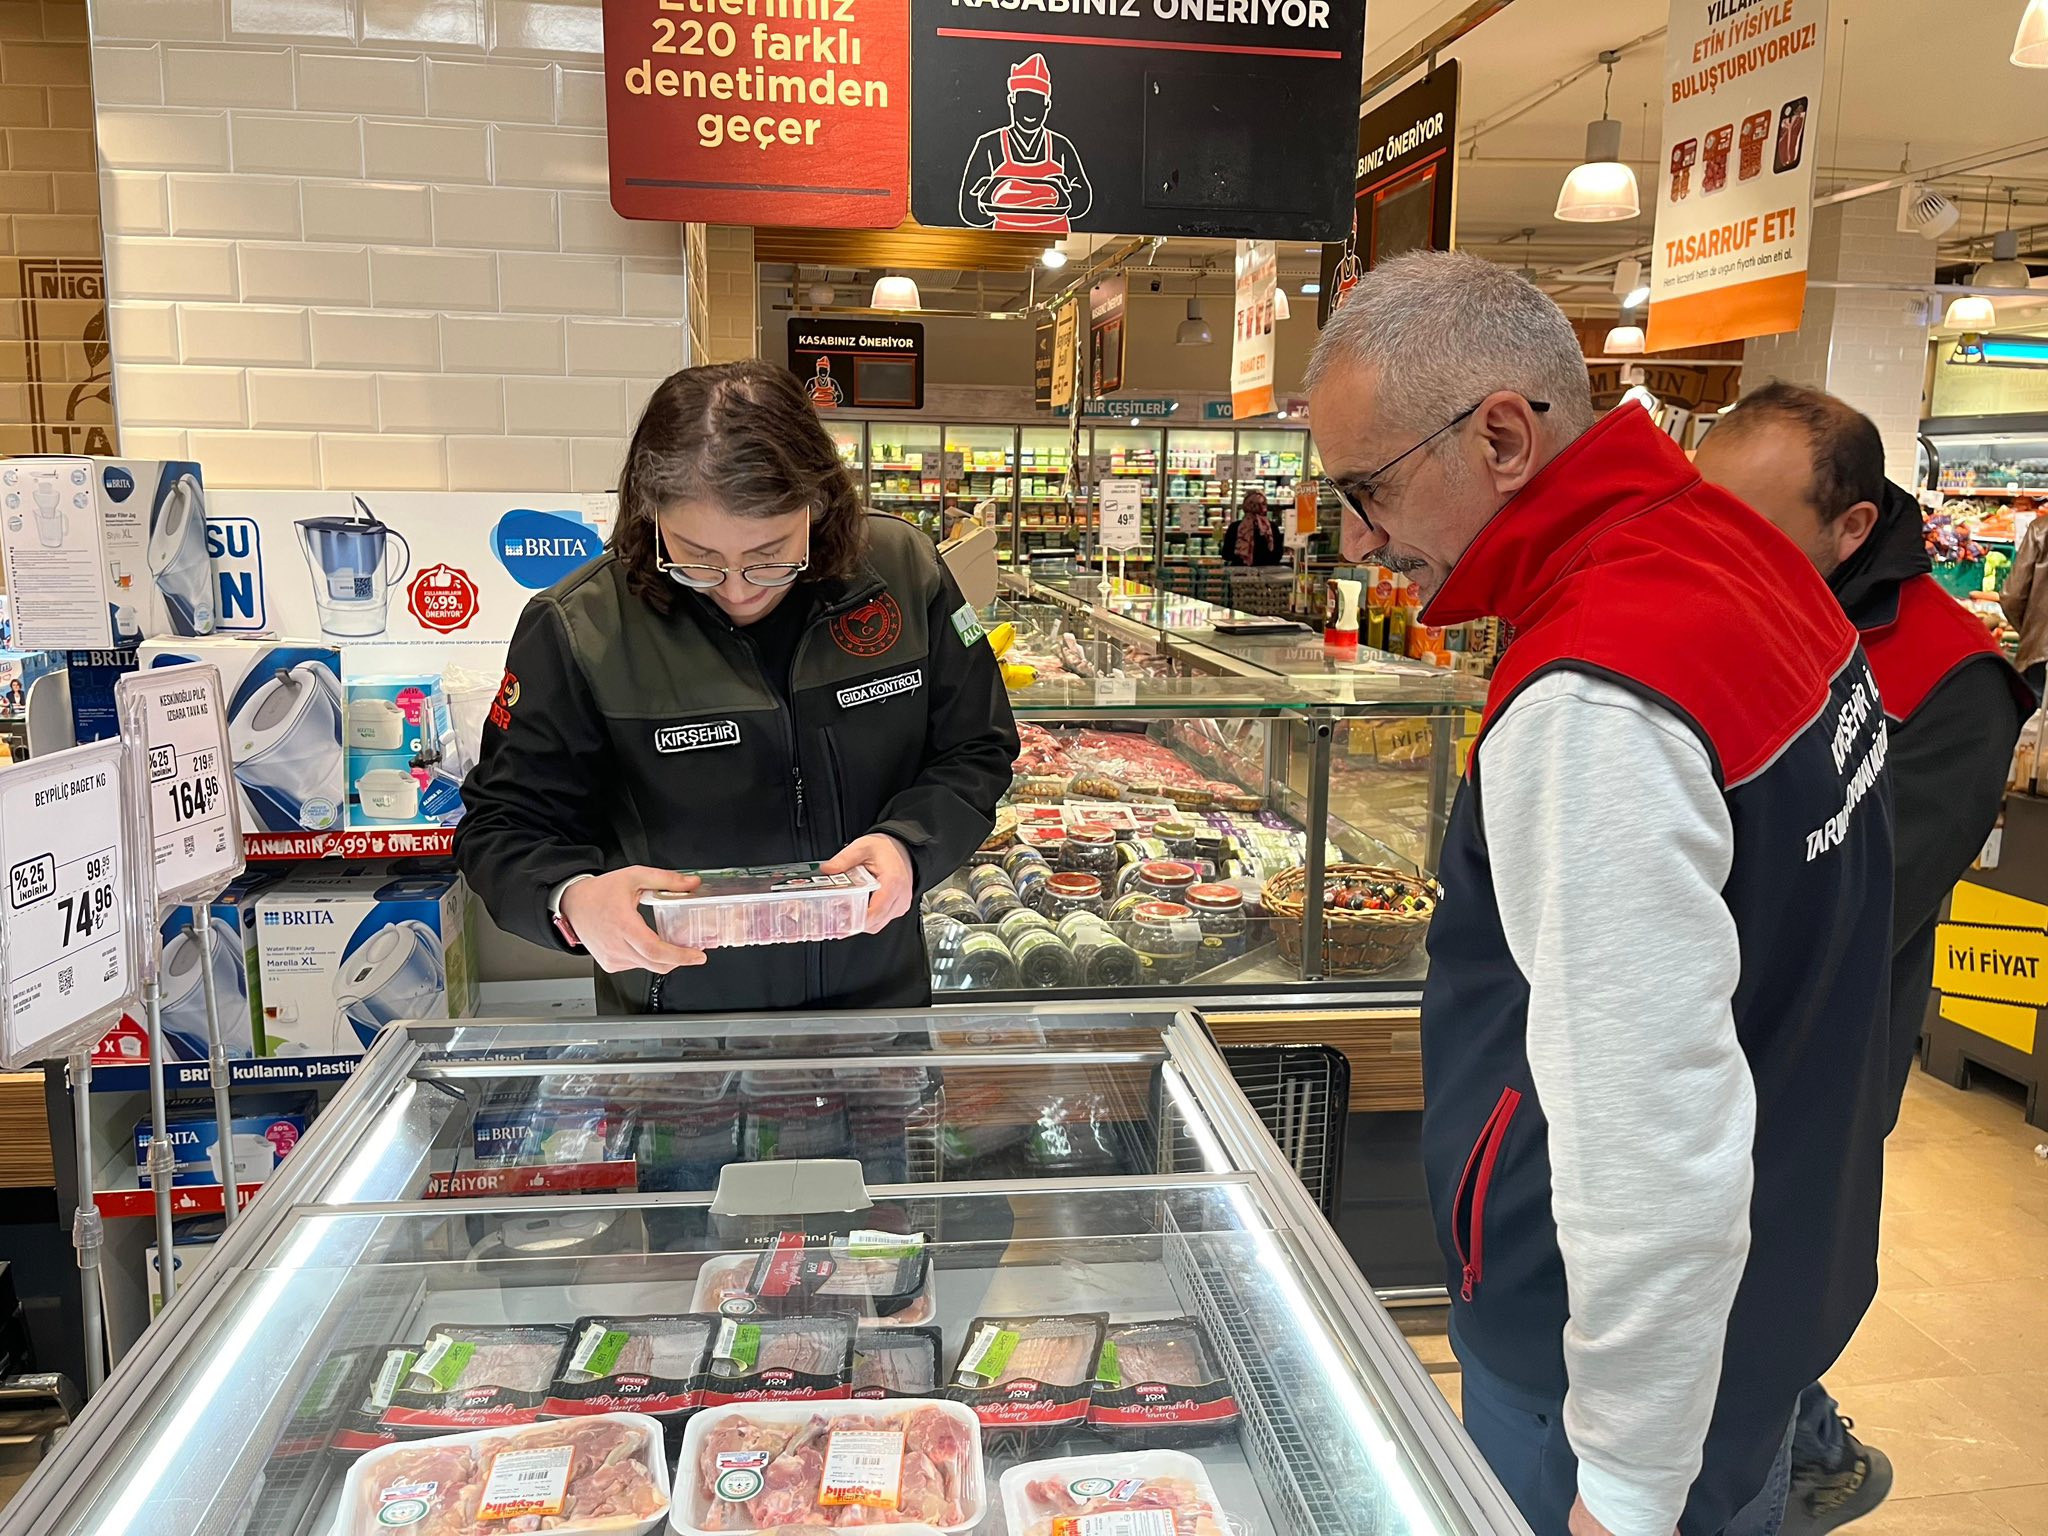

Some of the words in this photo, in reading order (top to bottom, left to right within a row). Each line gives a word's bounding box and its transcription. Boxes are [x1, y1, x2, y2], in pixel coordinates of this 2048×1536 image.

[1692, 28, 1725, 64] ETİN
[1728, 0, 1793, 48] İYİSİYLE
[652, 18, 737, 57] 220
[752, 23, 861, 65] farklı
[1672, 23, 1816, 103] BULUŞTURUYORUZ!
[624, 59, 889, 108] denetimden
[697, 112, 821, 150] geçer
[1386, 111, 1443, 161] ÖNERİYOR
[1666, 217, 1758, 268] TASARRUF
[1763, 207, 1796, 244] ET!
[799, 335, 856, 346] KASABINIZ
[859, 335, 914, 348] ÖNERİYOR
[1062, 400, 1105, 413] PNİR
[1108, 400, 1166, 415] ÇEŞİTLERİ
[112, 479, 131, 488] BRITA
[122, 528, 133, 538] XL
[525, 538, 587, 556] BRITA
[841, 689, 869, 705] GIDA
[870, 674, 918, 697] KONTROL
[187, 705, 201, 718] TAVA
[200, 703, 208, 715] KG
[1831, 683, 1871, 775] KIRŞEHİR
[35, 783, 69, 807] BEYPİLİÇ
[70, 776, 94, 796] BAGET
[96, 772, 106, 788] KG
[388, 832, 454, 851] ÖNERİY
[20, 883, 48, 901] İNDİRİM
[57, 884, 112, 947] 74,96
[283, 910, 334, 925] BRITA
[267, 959, 299, 967] Marella
[301, 956, 317, 966] XL
[1949, 944, 1975, 971] İYİ
[1980, 949, 2040, 978] FİYAT
[180, 1069, 212, 1082] BRI
[233, 1065, 303, 1080] kullanın,
[165, 1131, 200, 1144] RITA
[492, 1126, 533, 1141] BRITA
[428, 1174, 504, 1194] NERİYOR
[617, 1375, 648, 1386] kasap
[761, 1371, 793, 1380] kasap
[618, 1383, 641, 1393] köf
[854, 1390, 885, 1399] kasap
[1005, 1382, 1037, 1391] kasap
[1008, 1390, 1030, 1399] köf
[1144, 1393, 1165, 1401] köf
